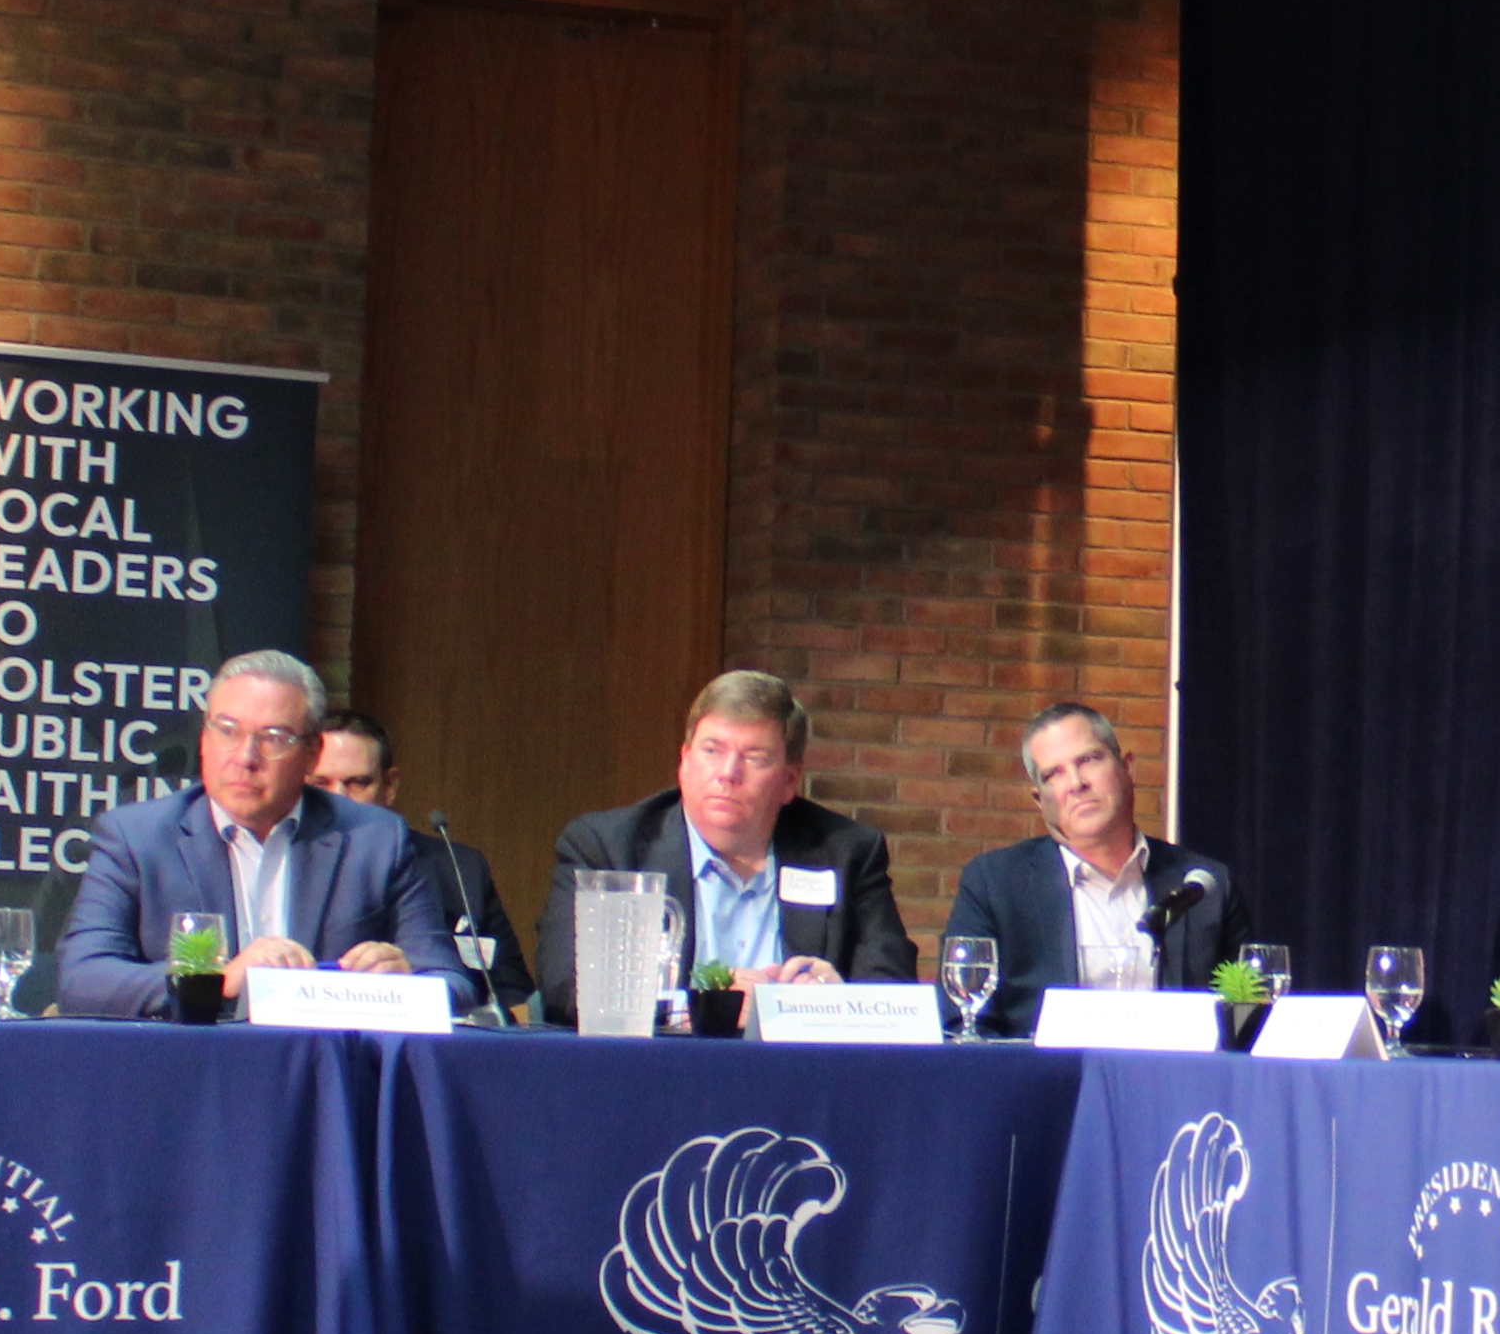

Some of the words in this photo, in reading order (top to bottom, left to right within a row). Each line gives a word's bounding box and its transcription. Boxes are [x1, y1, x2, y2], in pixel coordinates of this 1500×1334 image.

[296, 984, 316, 1000] Al
[322, 986, 404, 1005] Schmidt
[776, 999, 842, 1016] Lamont
[847, 1000, 919, 1017] McClure
[33, 1260, 182, 1321] Ford
